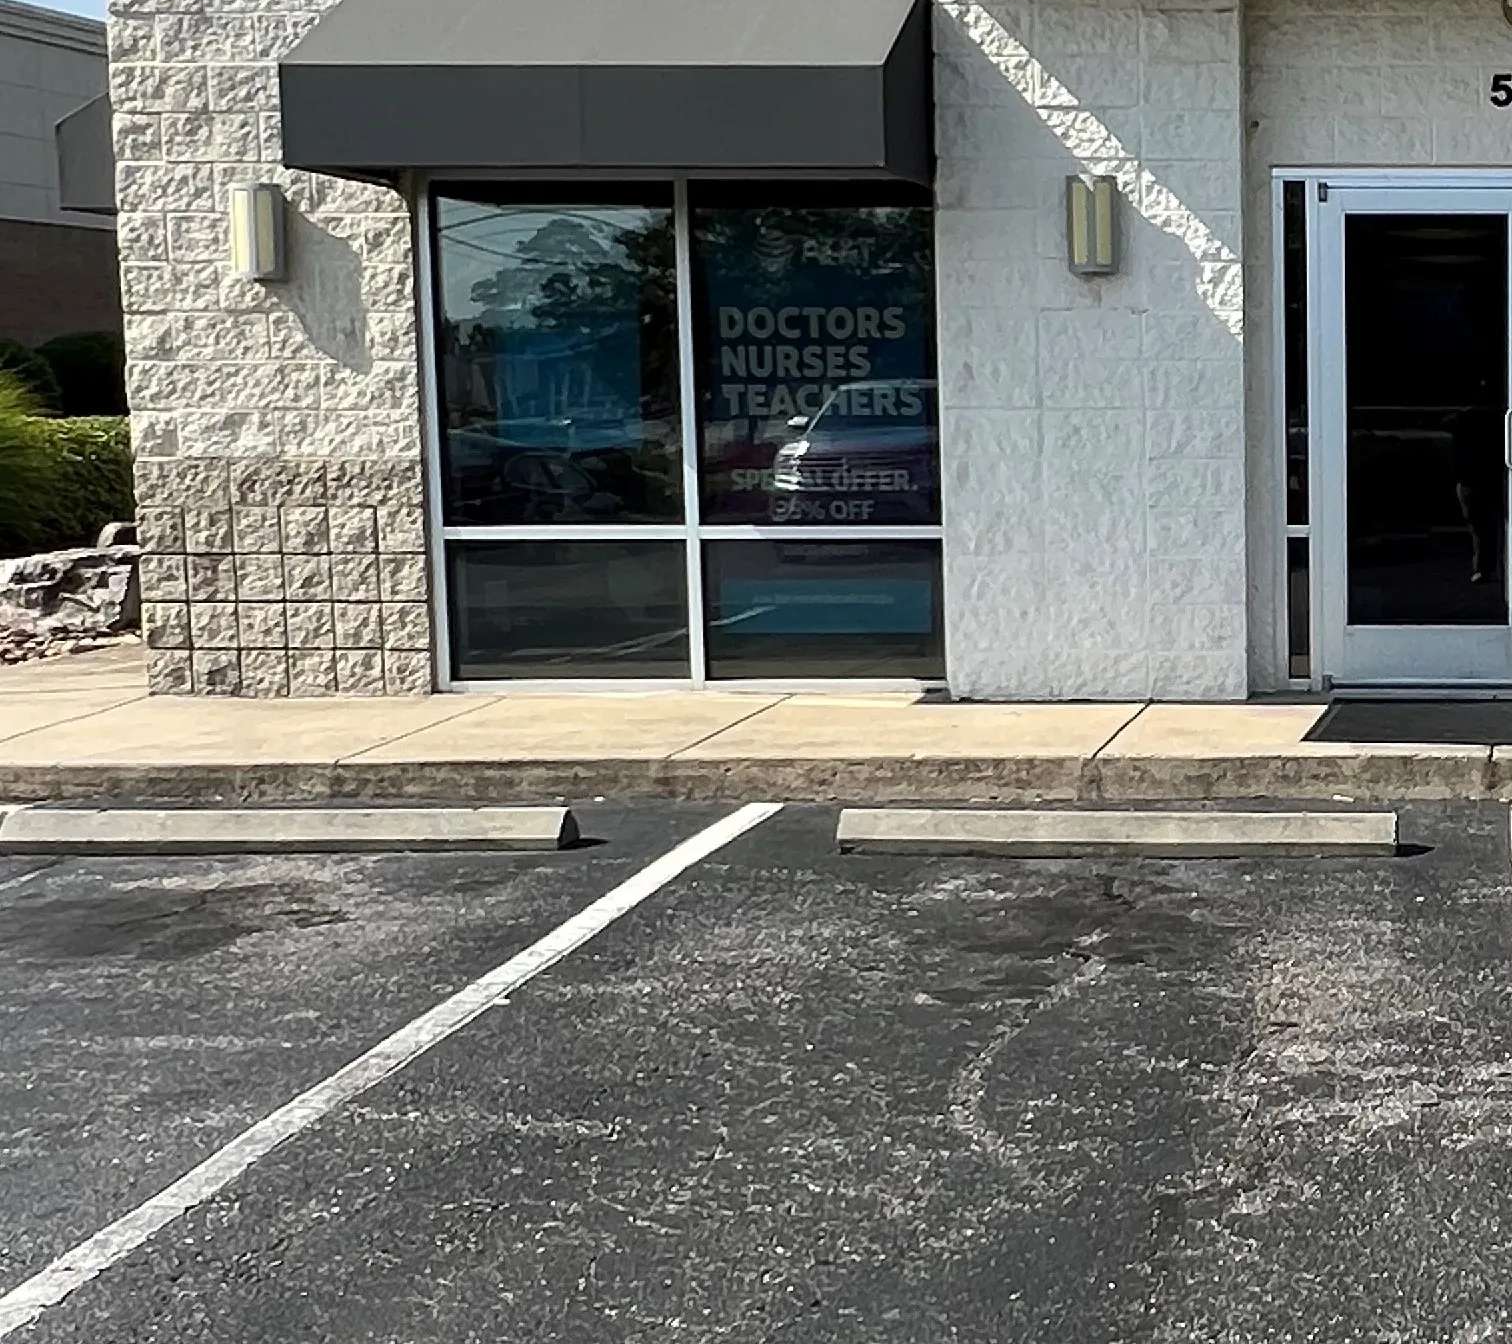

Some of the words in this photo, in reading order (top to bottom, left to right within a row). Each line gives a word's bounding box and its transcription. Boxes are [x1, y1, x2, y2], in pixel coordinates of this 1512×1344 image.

[719, 306, 906, 339] DOCTORS
[721, 346, 871, 377] NURSES
[722, 383, 923, 416] TEACHERS
[730, 468, 829, 492] SPEAL
[829, 500, 875, 520] OFF
